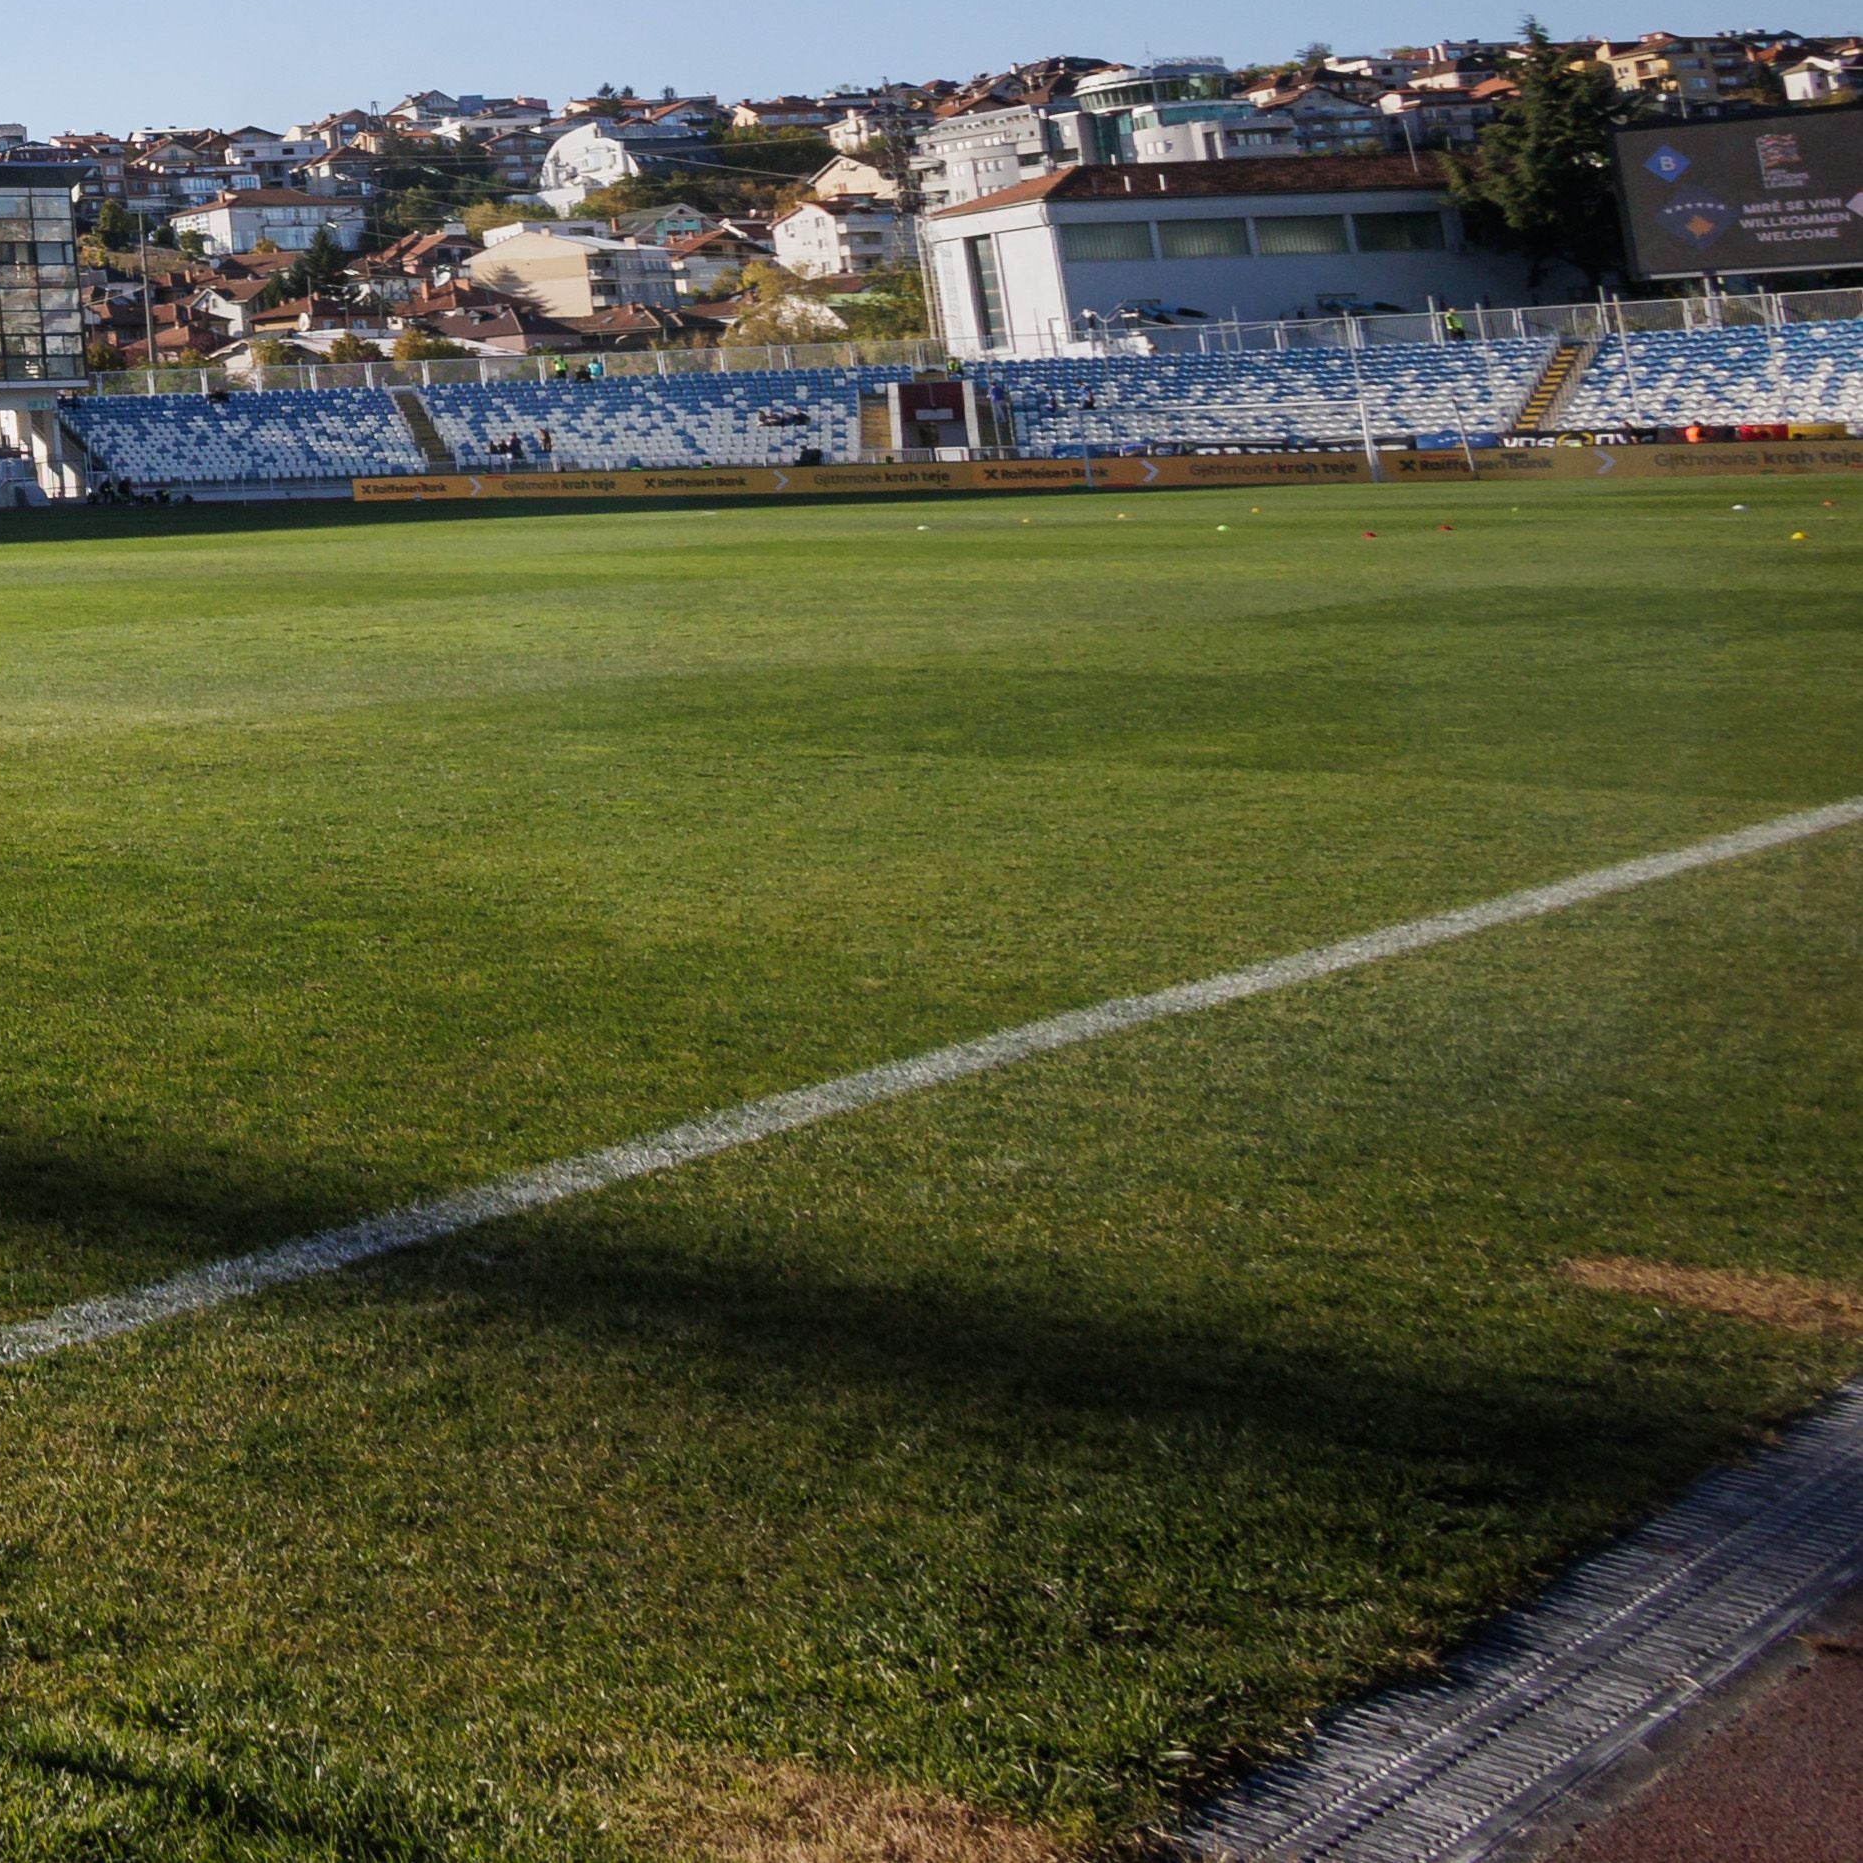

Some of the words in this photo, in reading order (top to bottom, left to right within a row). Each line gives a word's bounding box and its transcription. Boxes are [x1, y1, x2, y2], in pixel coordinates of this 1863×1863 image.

[1660, 155, 1676, 172] B
[1742, 199, 1782, 214] MIRË
[1785, 200, 1805, 212] SE
[1808, 198, 1842, 209] VINI
[1739, 211, 1852, 229] WILLKOMMEN
[1755, 227, 1839, 242] WELCOME
[1762, 450, 1814, 465] krah
[1276, 462, 1317, 474] krah
[884, 471, 918, 483] krah
[921, 470, 951, 485] teje
